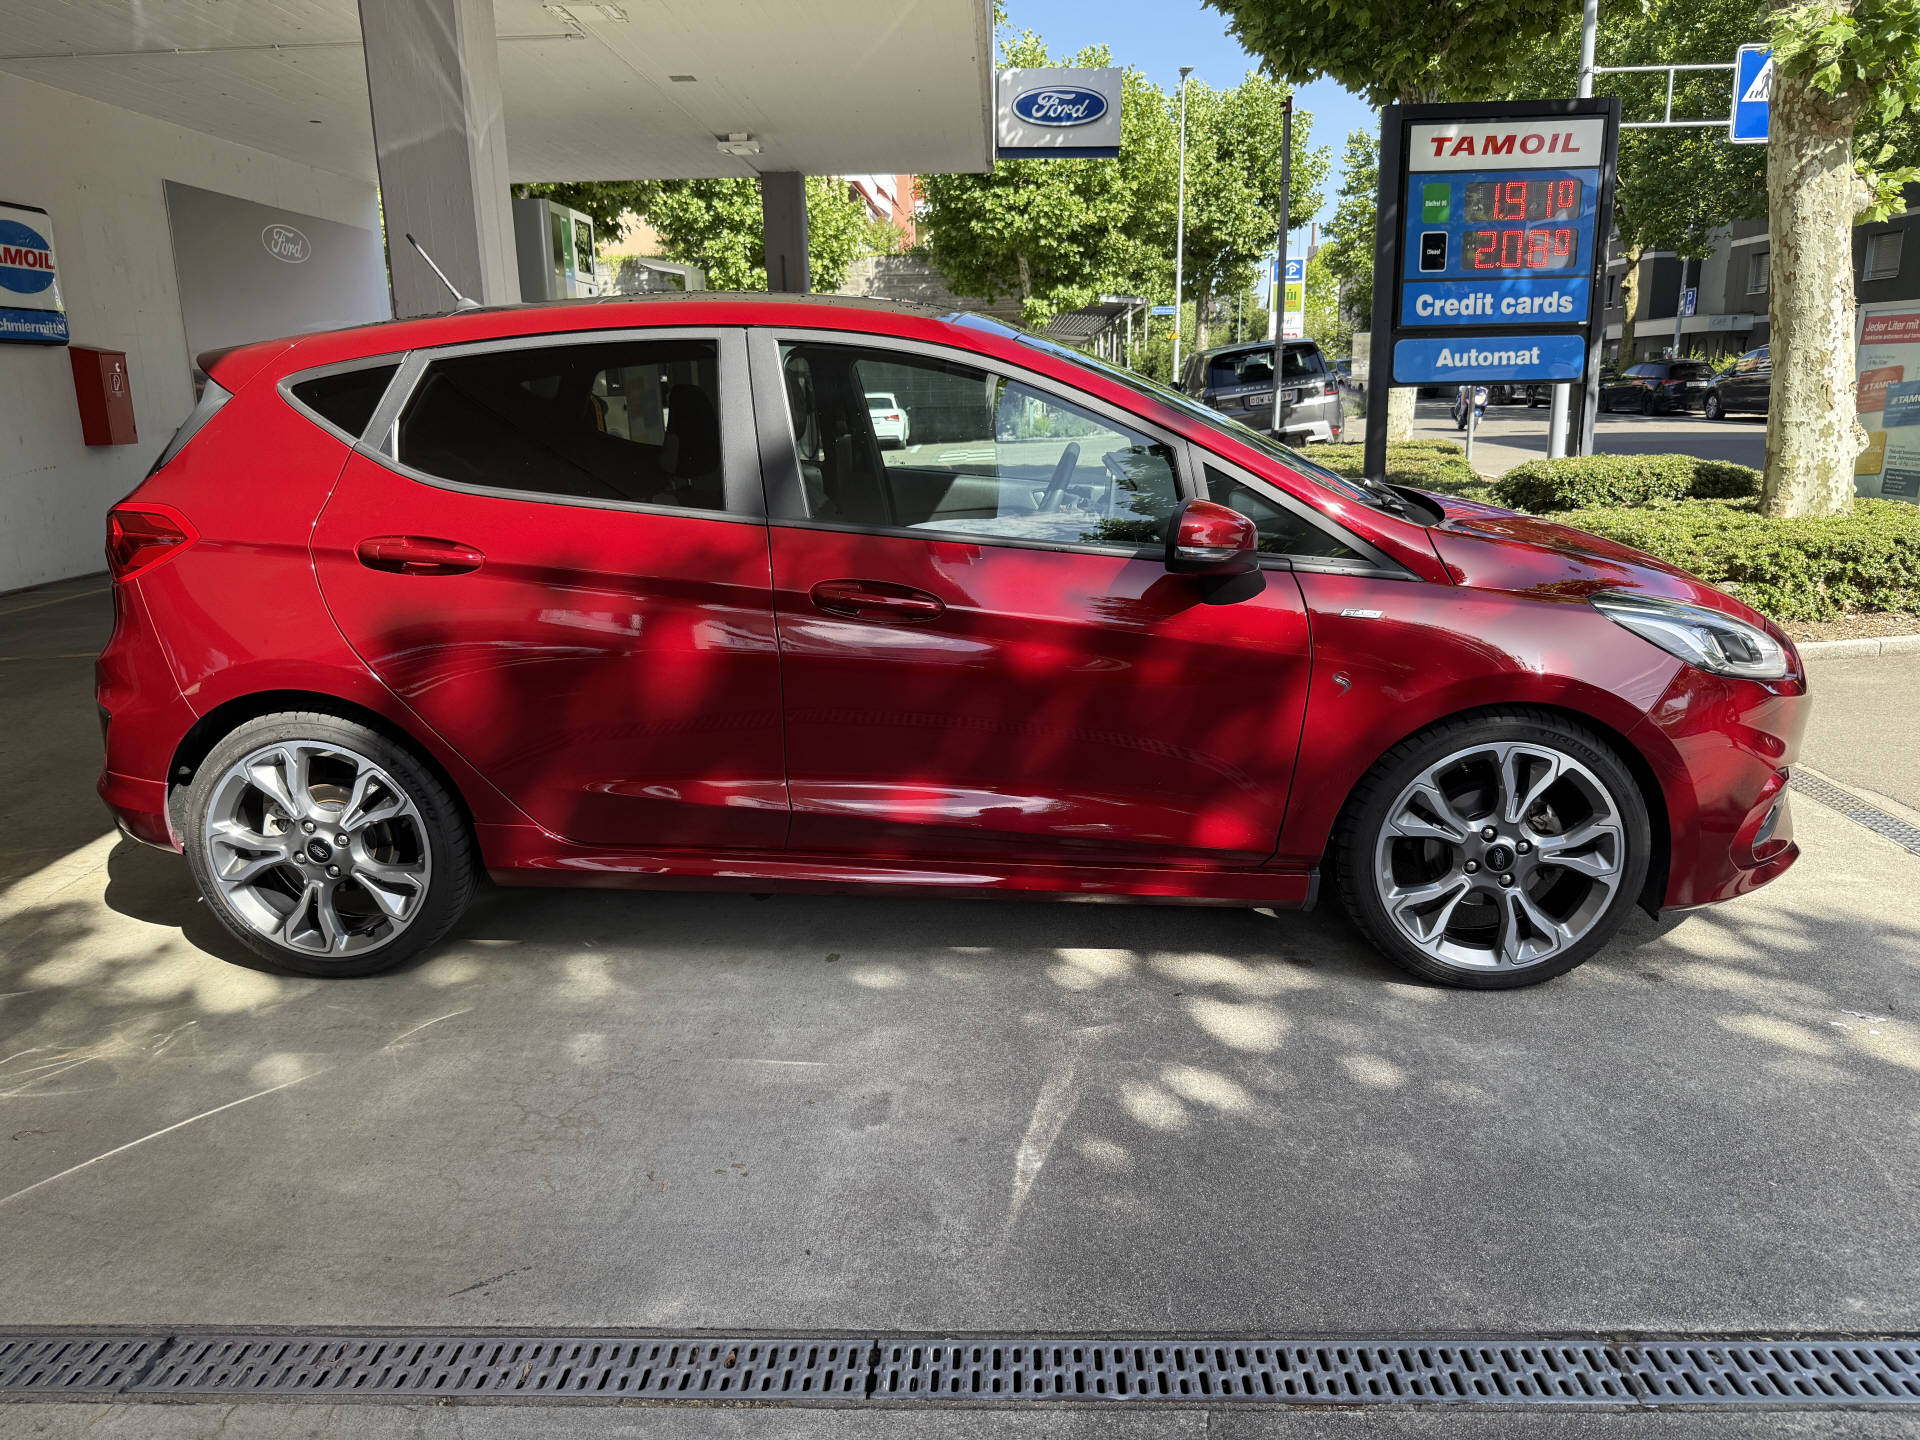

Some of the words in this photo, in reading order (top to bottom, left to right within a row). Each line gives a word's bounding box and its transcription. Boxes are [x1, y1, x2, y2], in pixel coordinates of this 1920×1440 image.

[1031, 92, 1090, 118] Ford
[1430, 132, 1581, 157] TAMOIL
[272, 228, 304, 259] Ford
[1415, 293, 1493, 317] Credit
[1500, 291, 1573, 315] cards
[1865, 320, 1888, 332] Jeder
[1887, 319, 1906, 331] Liter
[1905, 318, 1920, 330] mit
[1435, 347, 1540, 368] Automat
